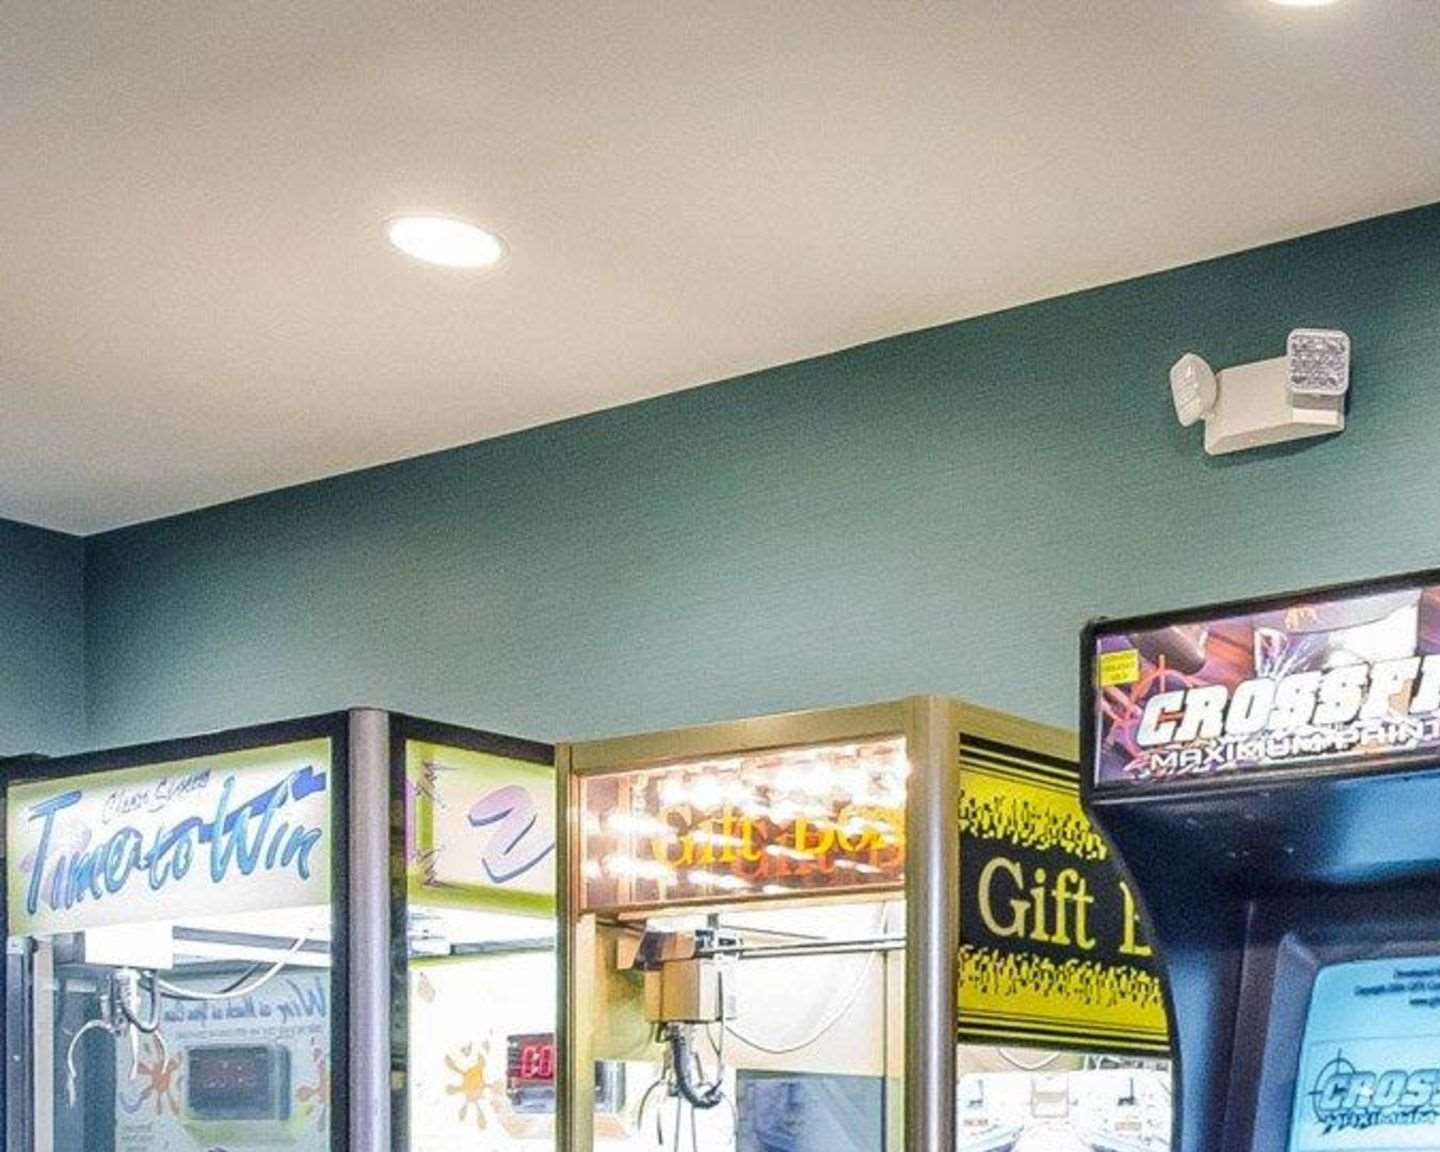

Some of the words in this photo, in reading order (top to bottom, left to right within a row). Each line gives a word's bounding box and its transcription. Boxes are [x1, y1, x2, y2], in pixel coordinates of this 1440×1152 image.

[1151, 730, 1327, 772] MAXIMUM
[209, 773, 323, 884] Win
[978, 856, 1097, 950] Gift
